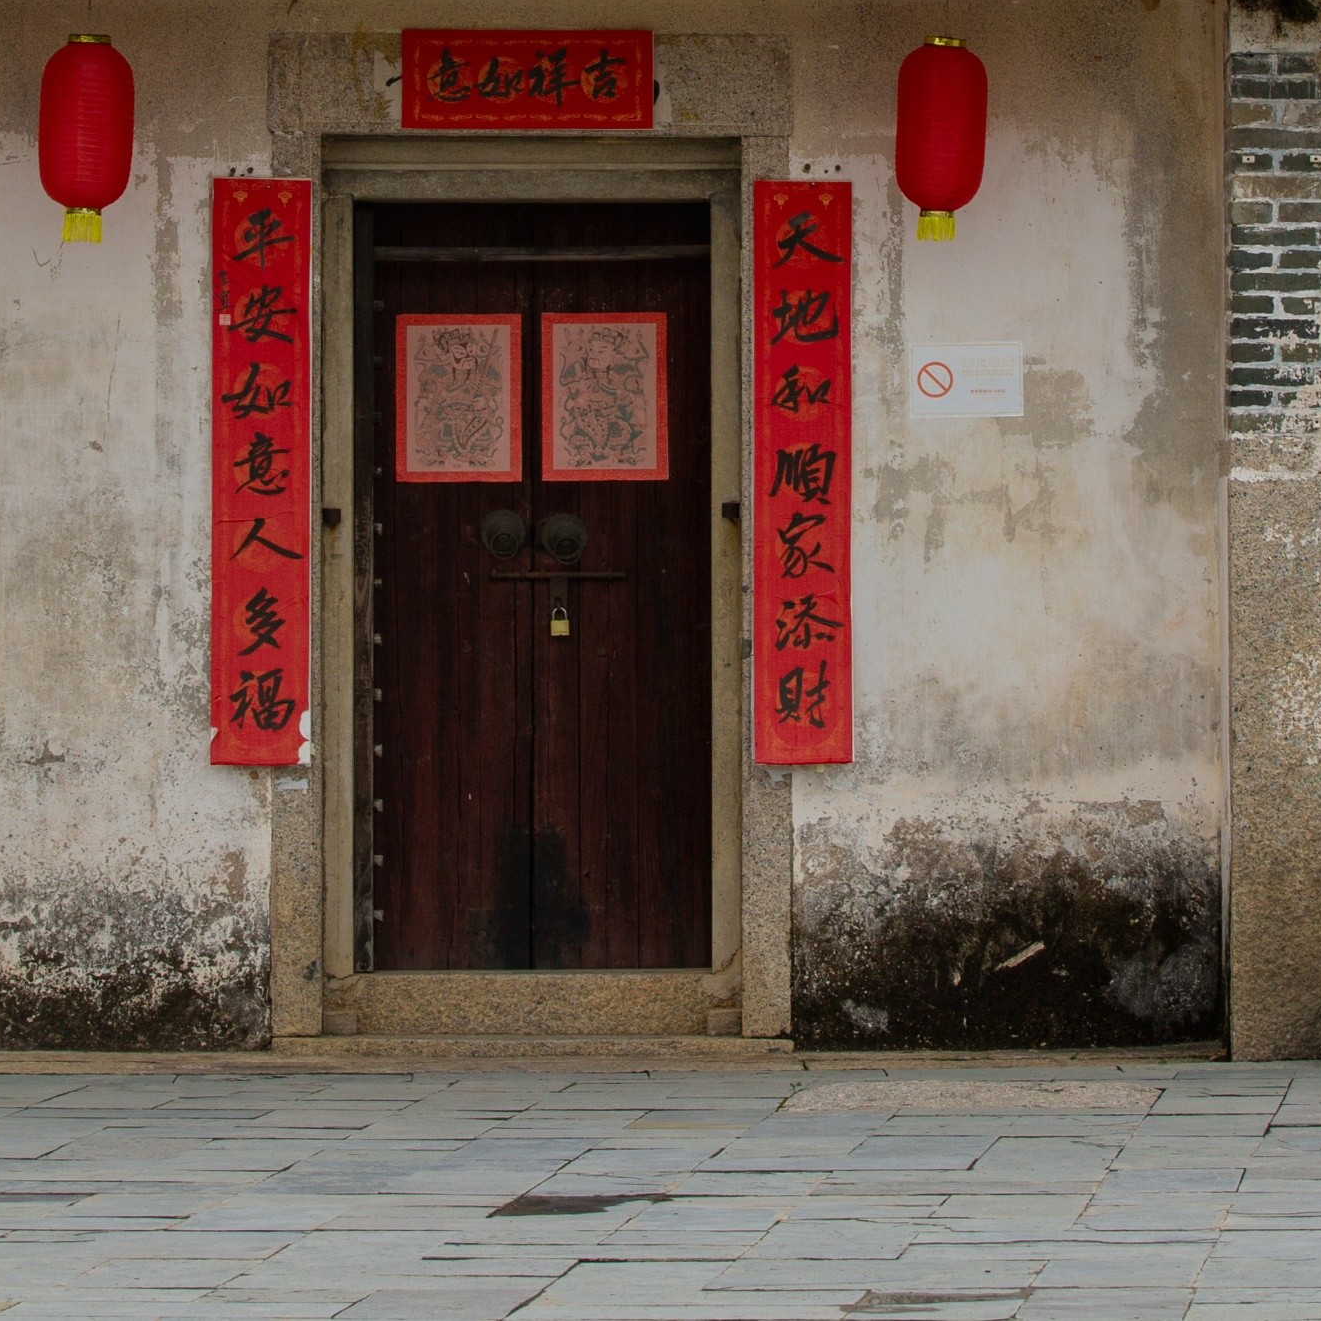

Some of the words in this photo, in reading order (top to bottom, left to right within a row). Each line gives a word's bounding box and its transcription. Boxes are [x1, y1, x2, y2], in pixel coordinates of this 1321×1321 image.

[221, 206, 303, 732] 平安如意人多福
